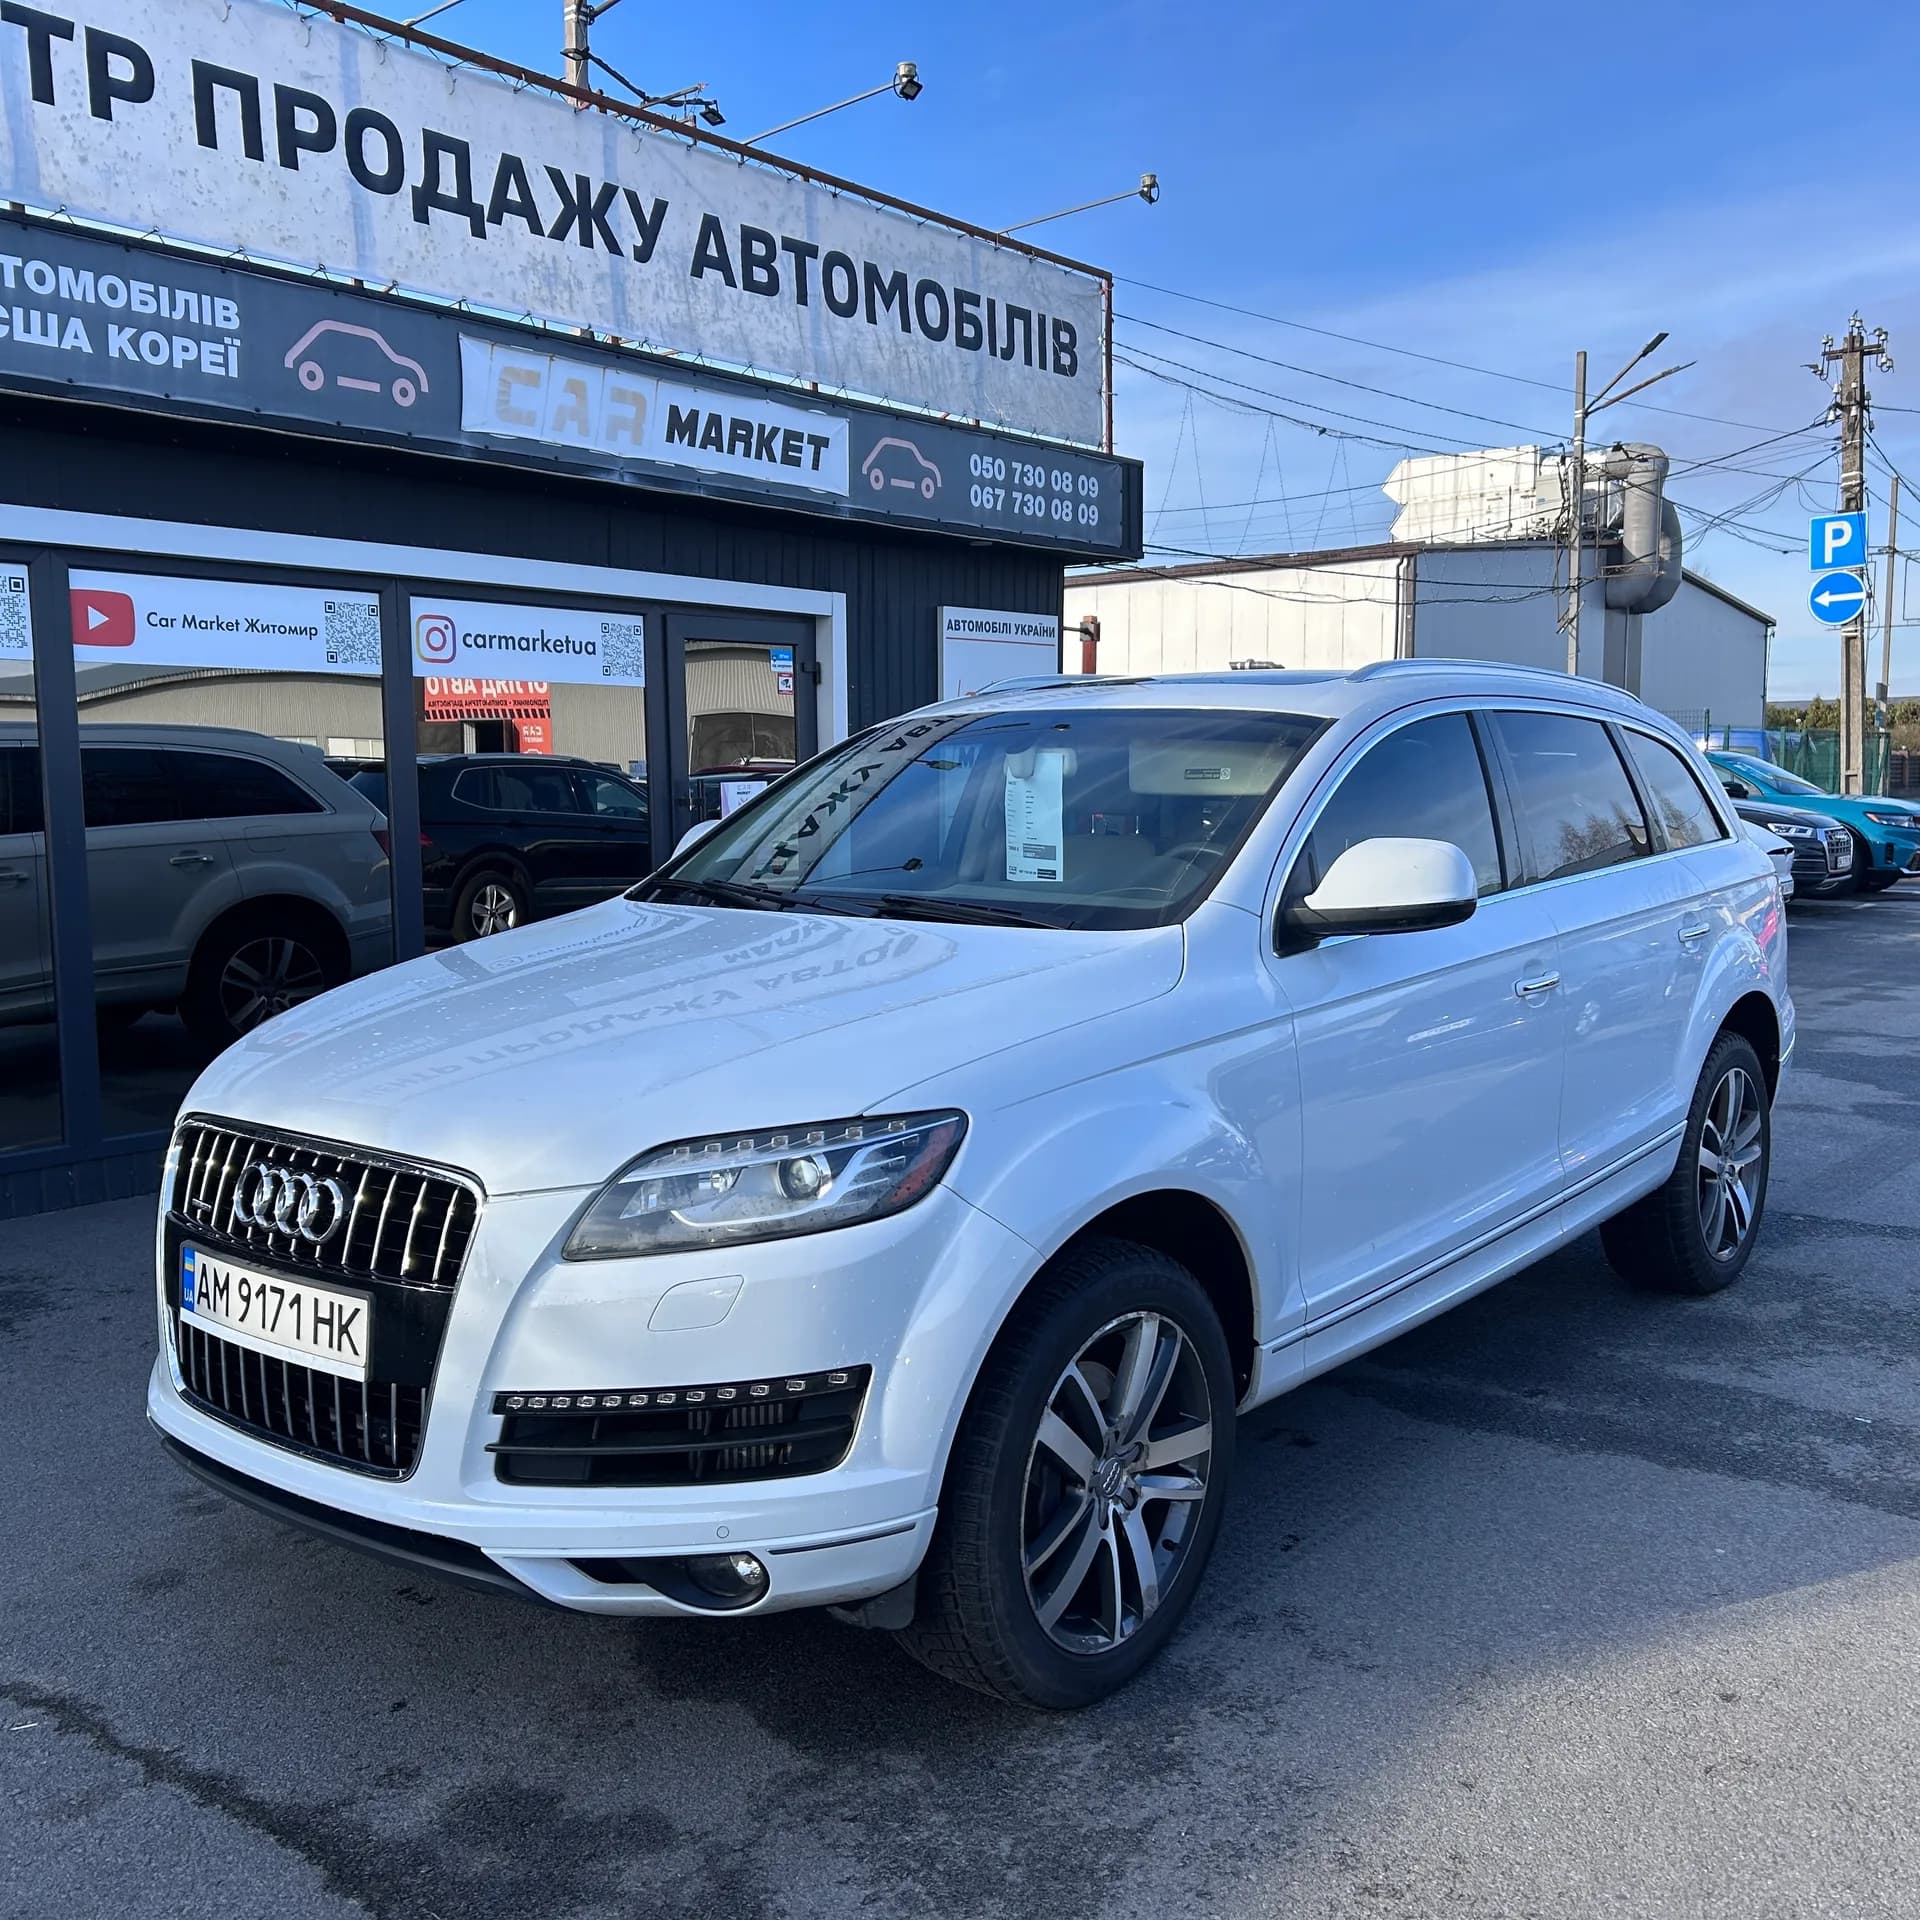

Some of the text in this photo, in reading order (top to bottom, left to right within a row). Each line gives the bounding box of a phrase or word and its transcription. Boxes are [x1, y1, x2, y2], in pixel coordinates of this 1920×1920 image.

[0, 4, 1078, 378] ТР ПРОДАЖУ АВТОМОБІЛІВ
[0, 254, 240, 329] ТОМОБІЛІВ
[108, 323, 241, 378] КОРЕЇ
[496, 366, 830, 471] CAR MARKET
[969, 453, 1099, 498] 050 730 08 09
[970, 484, 1099, 526] 067 730 08 09
[1824, 520, 1852, 564] P
[146, 612, 318, 641] Car Market Житомир
[462, 628, 597, 657] carmarketua
[946, 618, 1055, 638] АВТОМОБІЛІ УКРАЇНИ
[184, 1287, 194, 1304] UA
[196, 1263, 361, 1356] AM 9171 HK
